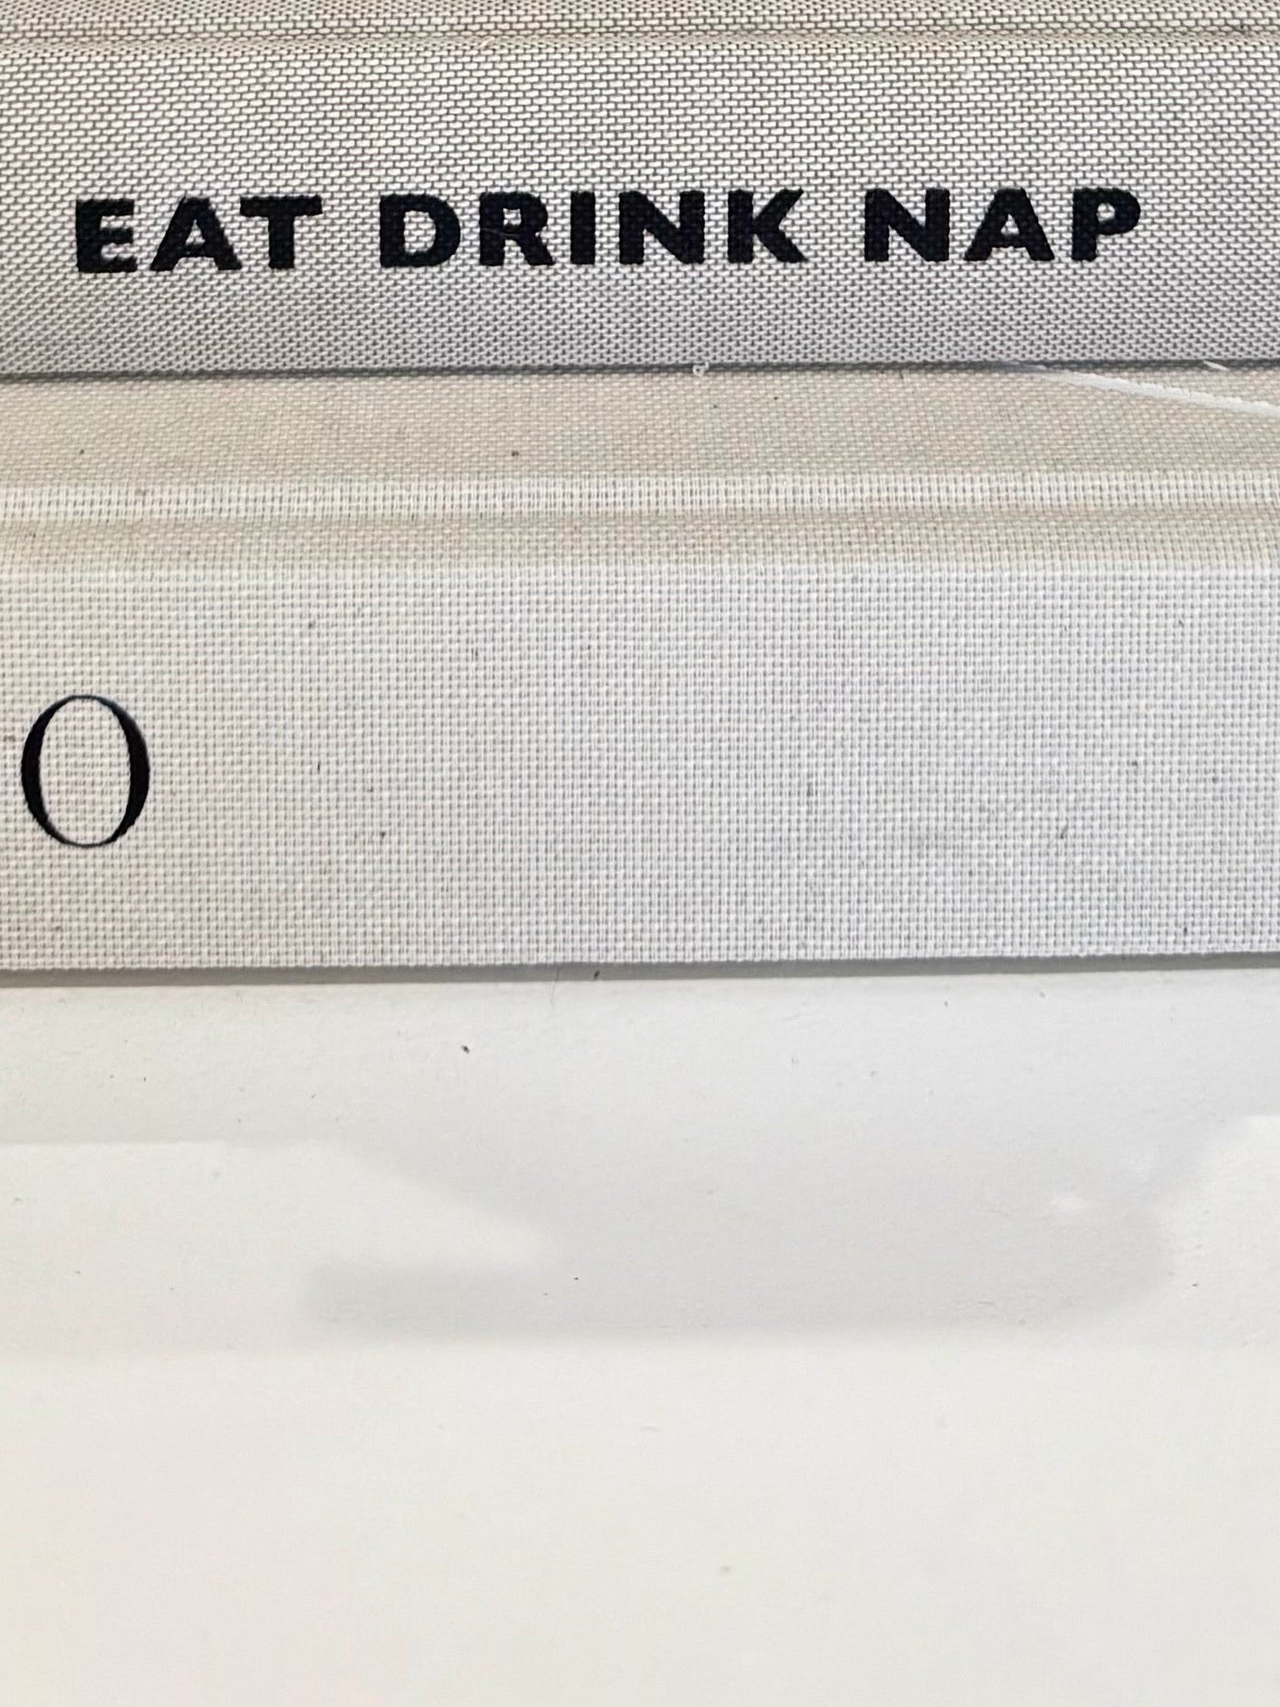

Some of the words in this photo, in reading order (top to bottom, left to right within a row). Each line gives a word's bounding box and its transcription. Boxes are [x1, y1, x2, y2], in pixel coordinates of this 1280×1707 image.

[75, 195, 322, 272] EAT
[378, 189, 806, 268] DRINK
[864, 188, 1141, 262] NAP
